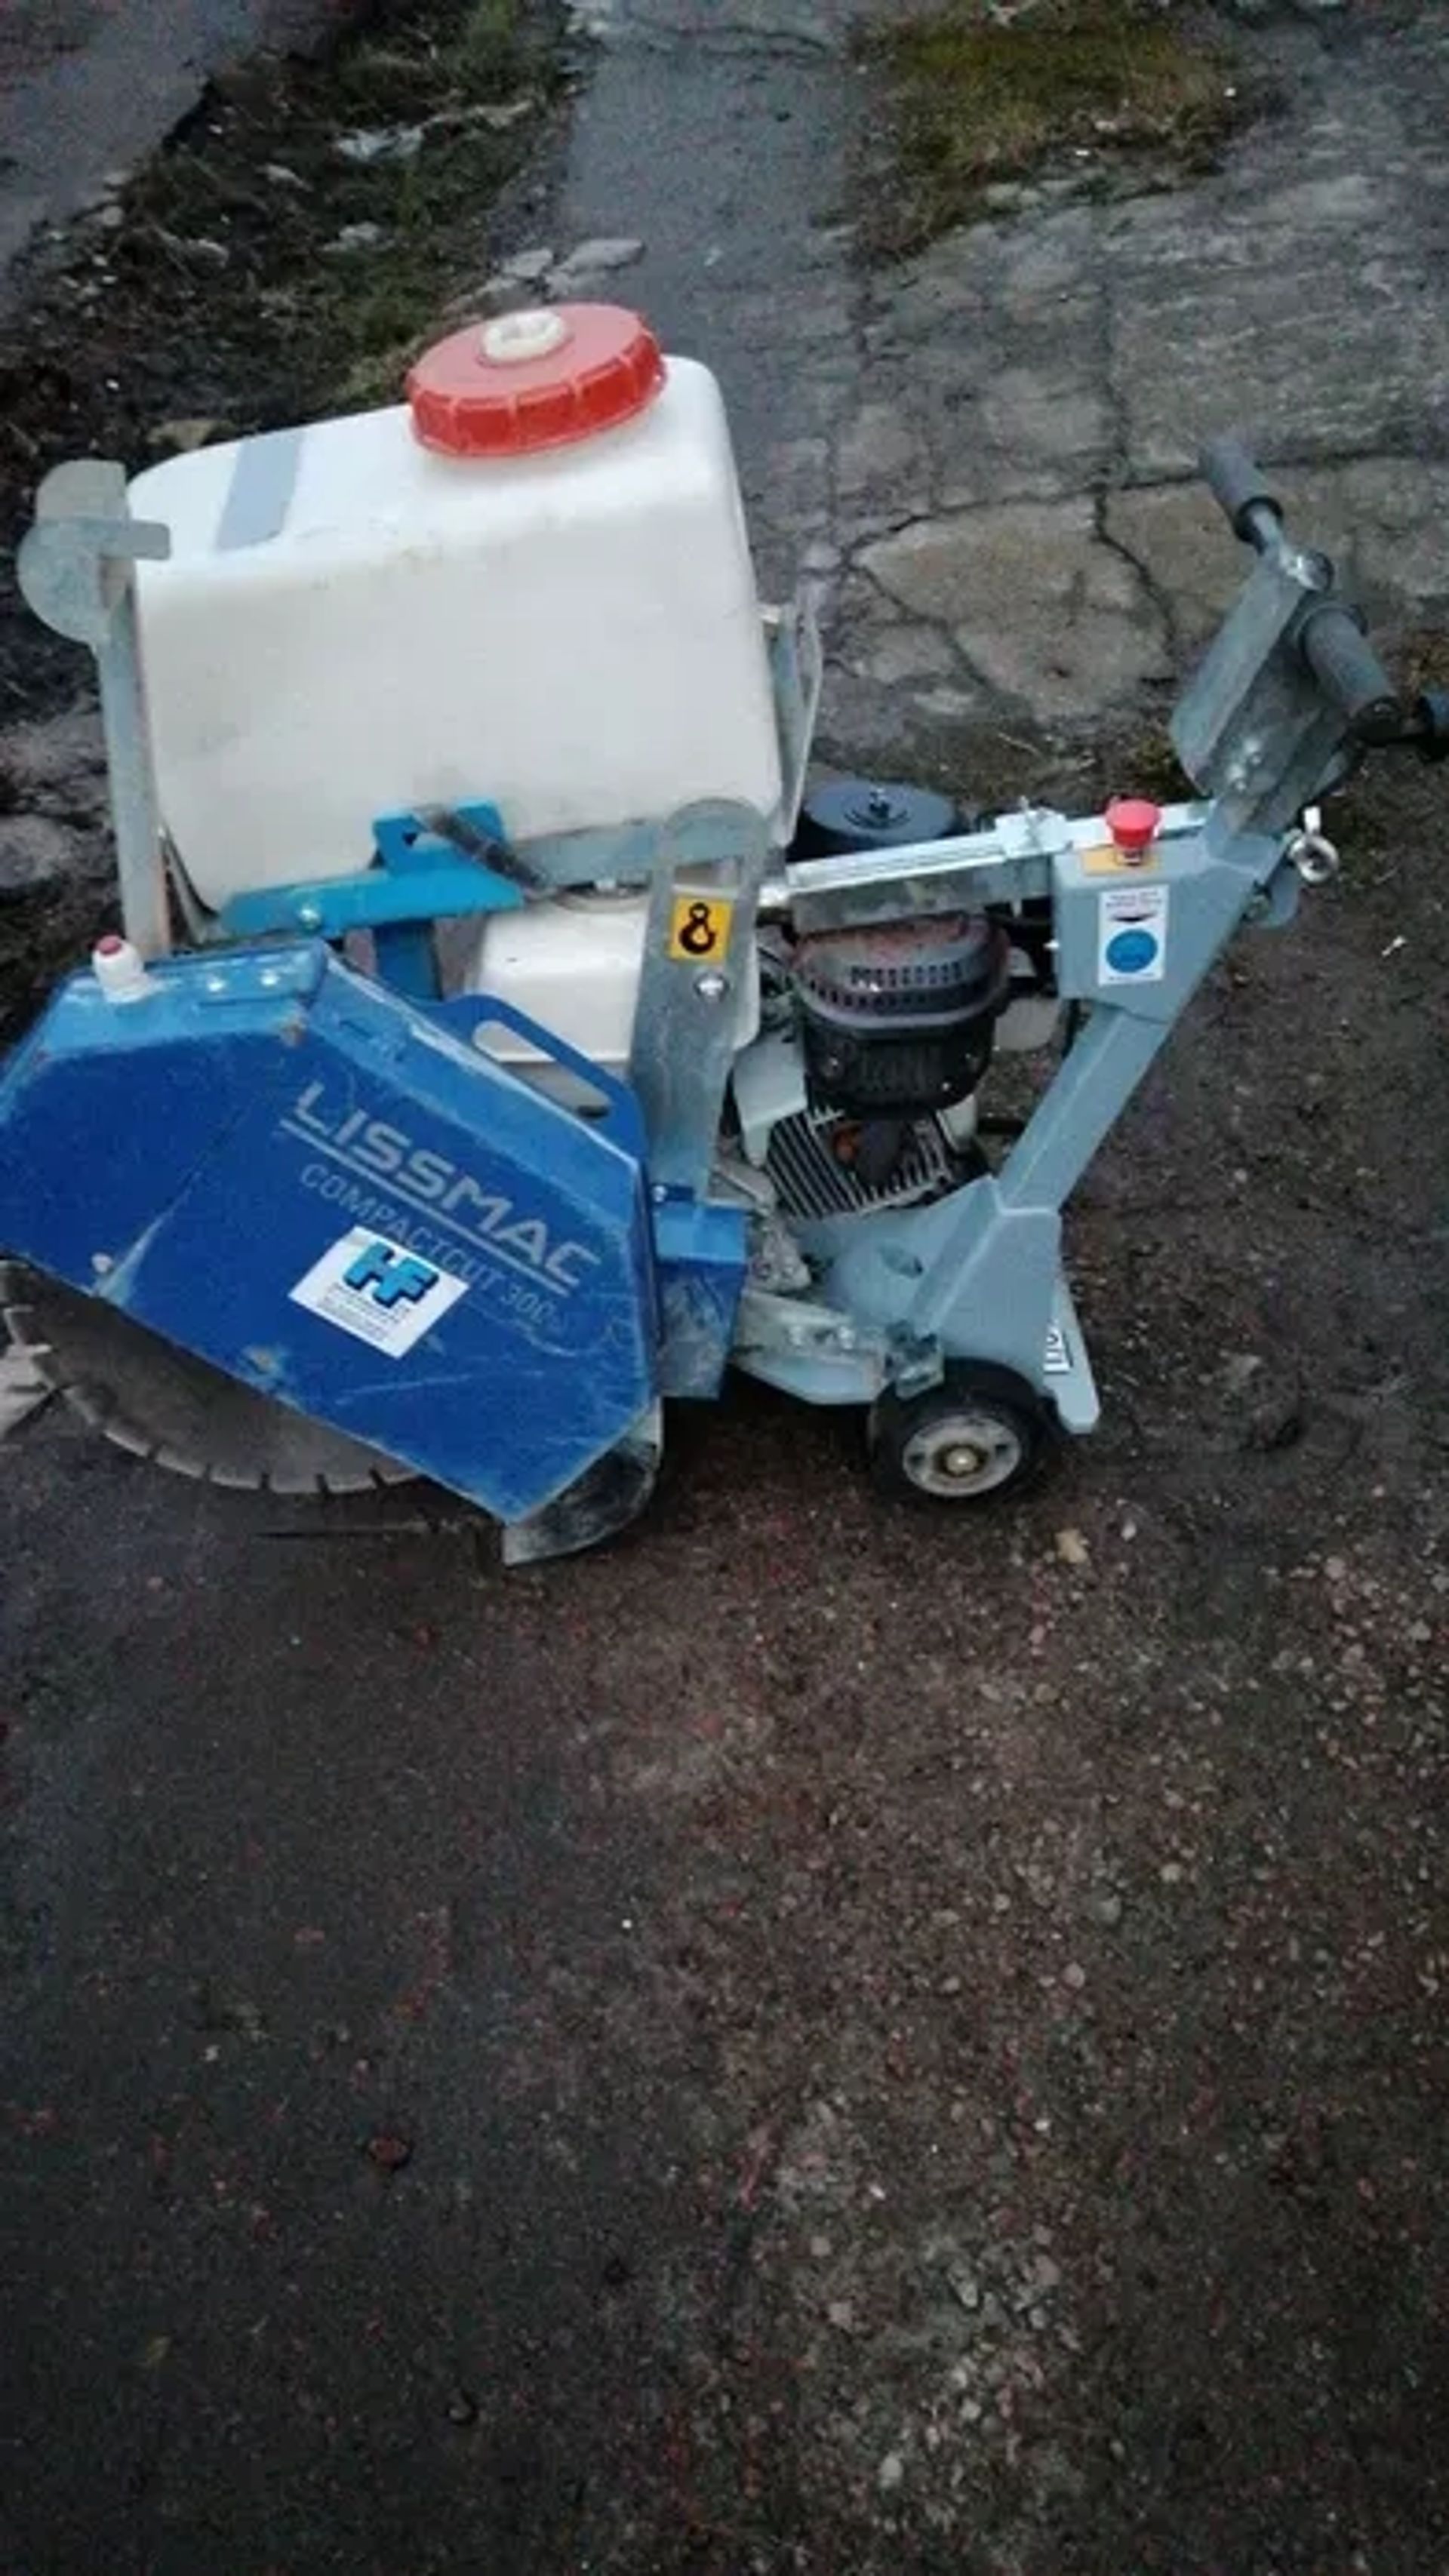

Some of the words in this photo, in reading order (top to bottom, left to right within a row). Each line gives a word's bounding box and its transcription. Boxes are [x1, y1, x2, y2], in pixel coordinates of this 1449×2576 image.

[296, 1083, 601, 1286] LISSMAC
[300, 1164, 506, 1291] COMPACTCUT
[343, 1242, 439, 1308] HF
